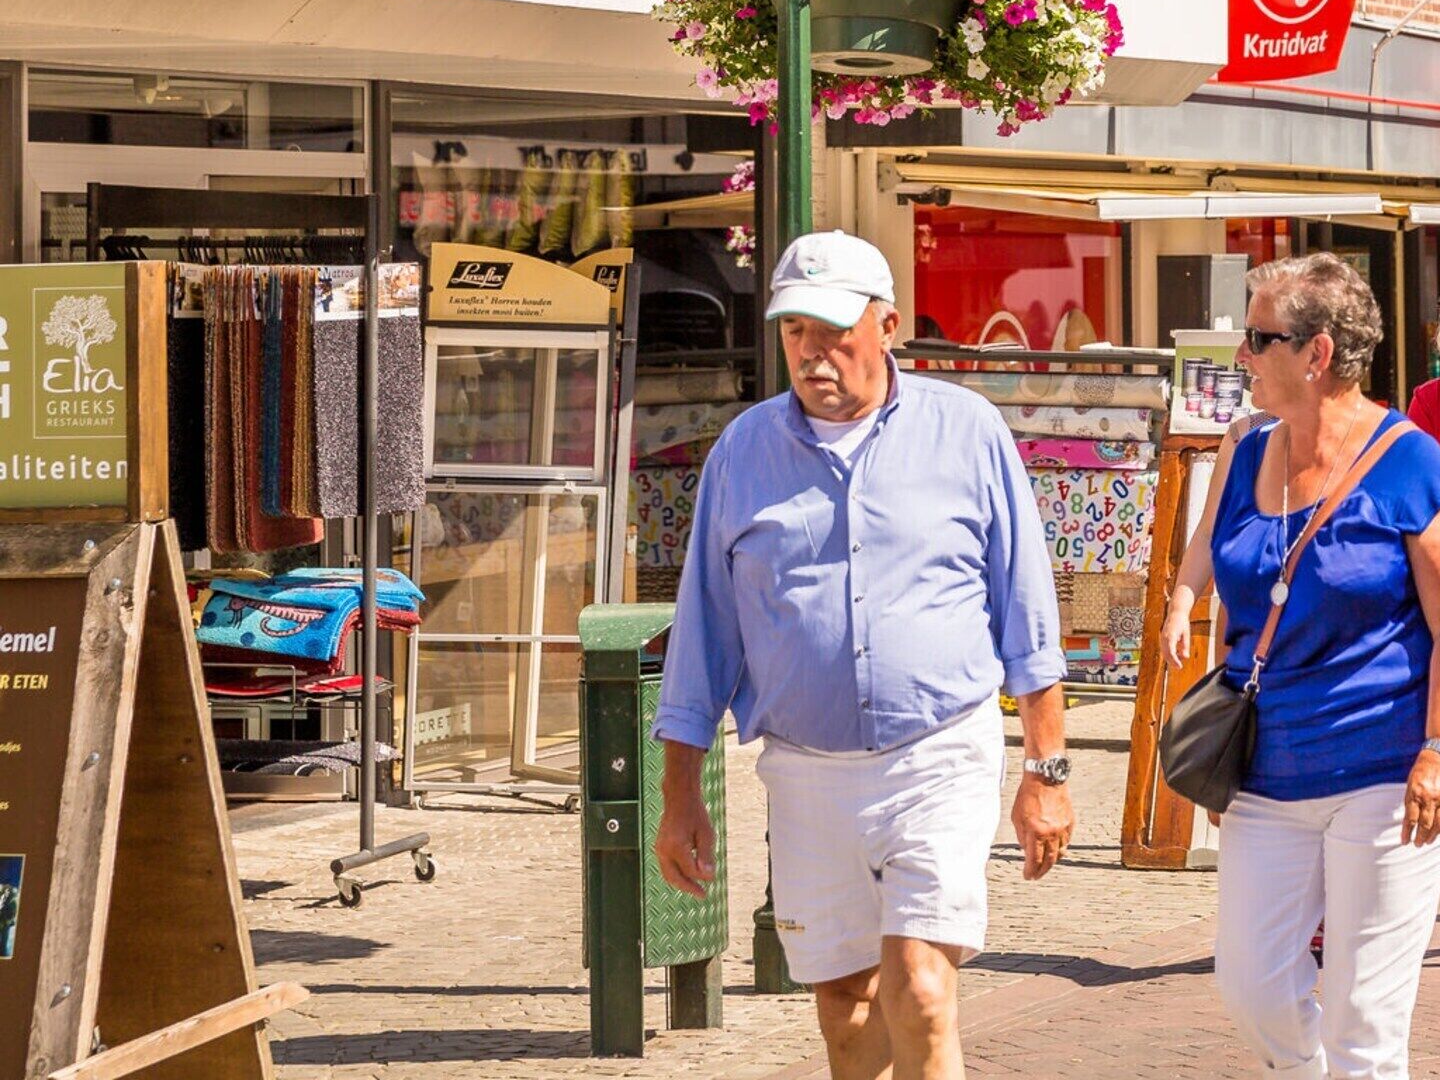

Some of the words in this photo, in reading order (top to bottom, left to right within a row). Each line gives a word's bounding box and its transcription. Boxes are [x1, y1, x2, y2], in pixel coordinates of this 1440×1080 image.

[1243, 30, 1328, 58] Kruidvat
[451, 263, 504, 287] Luxaflex
[43, 355, 124, 394] Elia
[46, 400, 116, 416] GRIEKS
[46, 417, 115, 428] RESTAURANT
[13, 674, 49, 689] ETEN
